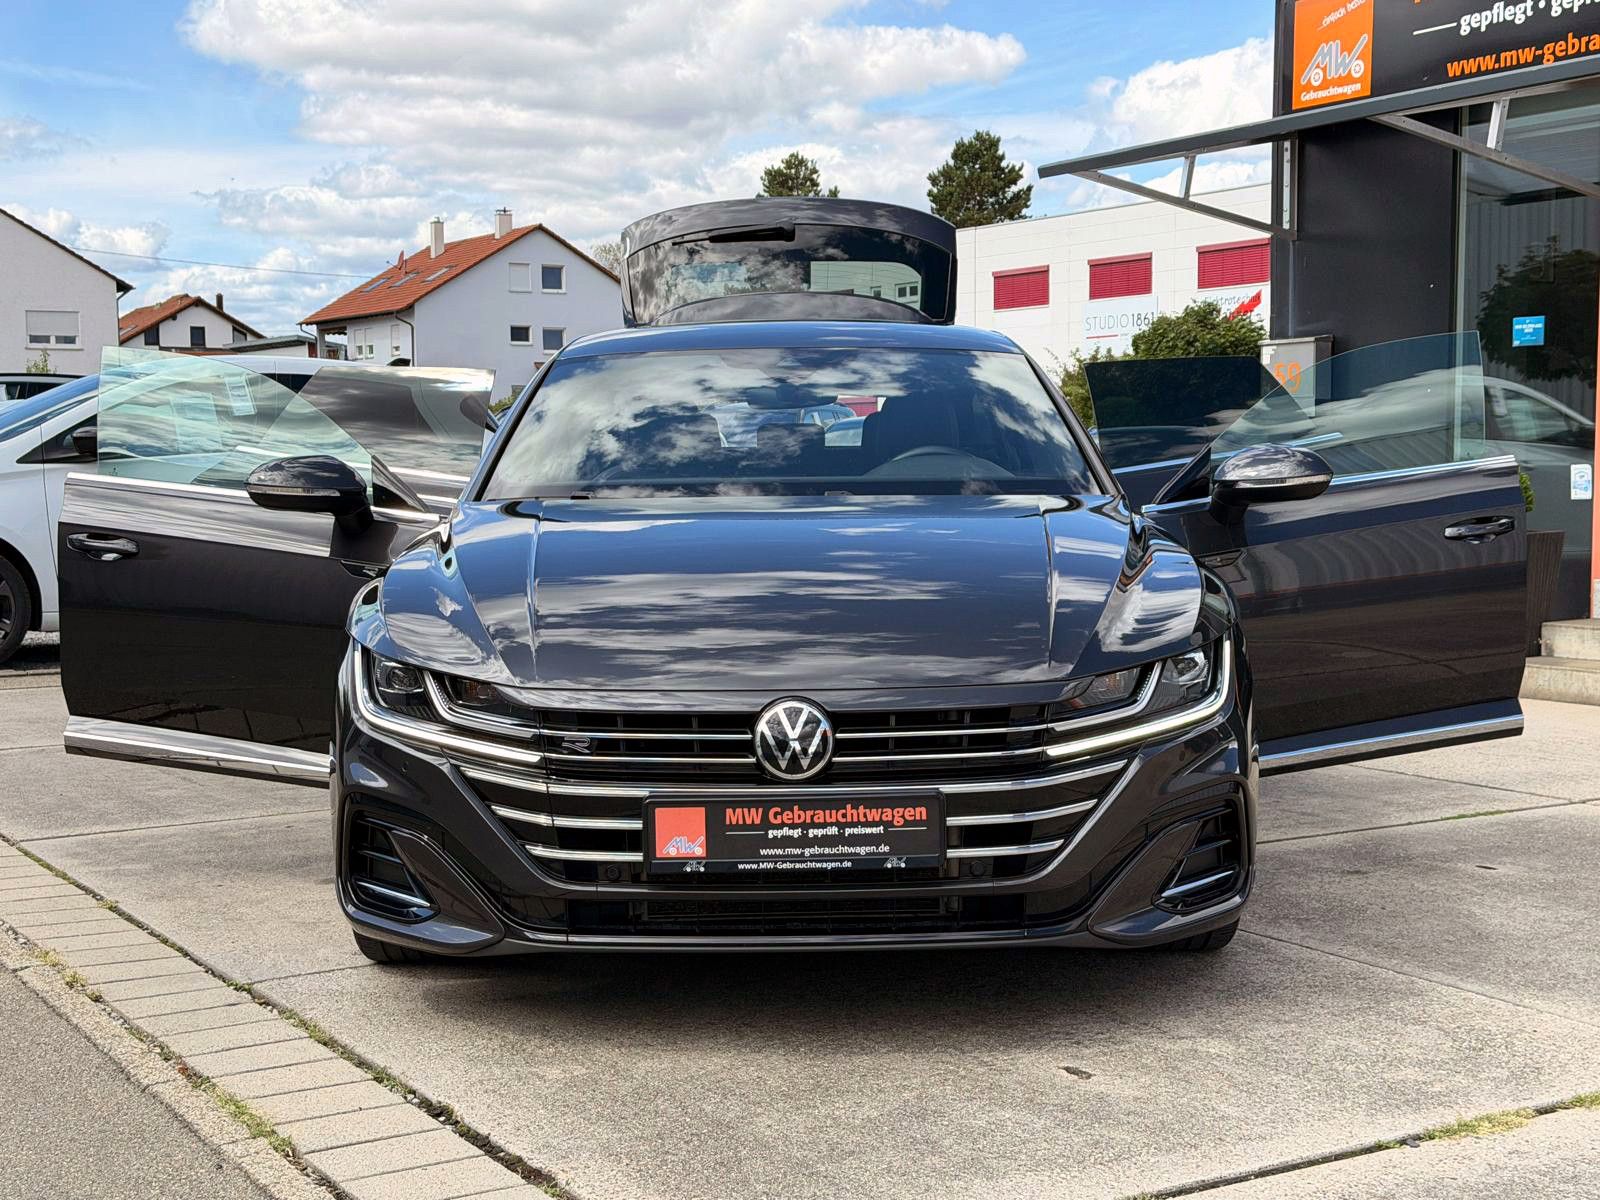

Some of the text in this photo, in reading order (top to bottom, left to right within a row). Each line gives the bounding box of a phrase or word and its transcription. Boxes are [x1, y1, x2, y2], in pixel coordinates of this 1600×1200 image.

[1459, 2, 1534, 36] gepflegt
[1446, 32, 1600, 78] www.mw-gebra
[1300, 83, 1362, 101] Gebrauchtwagen
[725, 804, 927, 826] MW Gebrauchtwagen
[767, 825, 884, 838] gepflegt geprüft preiswert
[760, 844, 890, 857] www.mw-gebrauchtwagen.de
[737, 860, 853, 870] www.MW-Gebrauchtwagen.de
